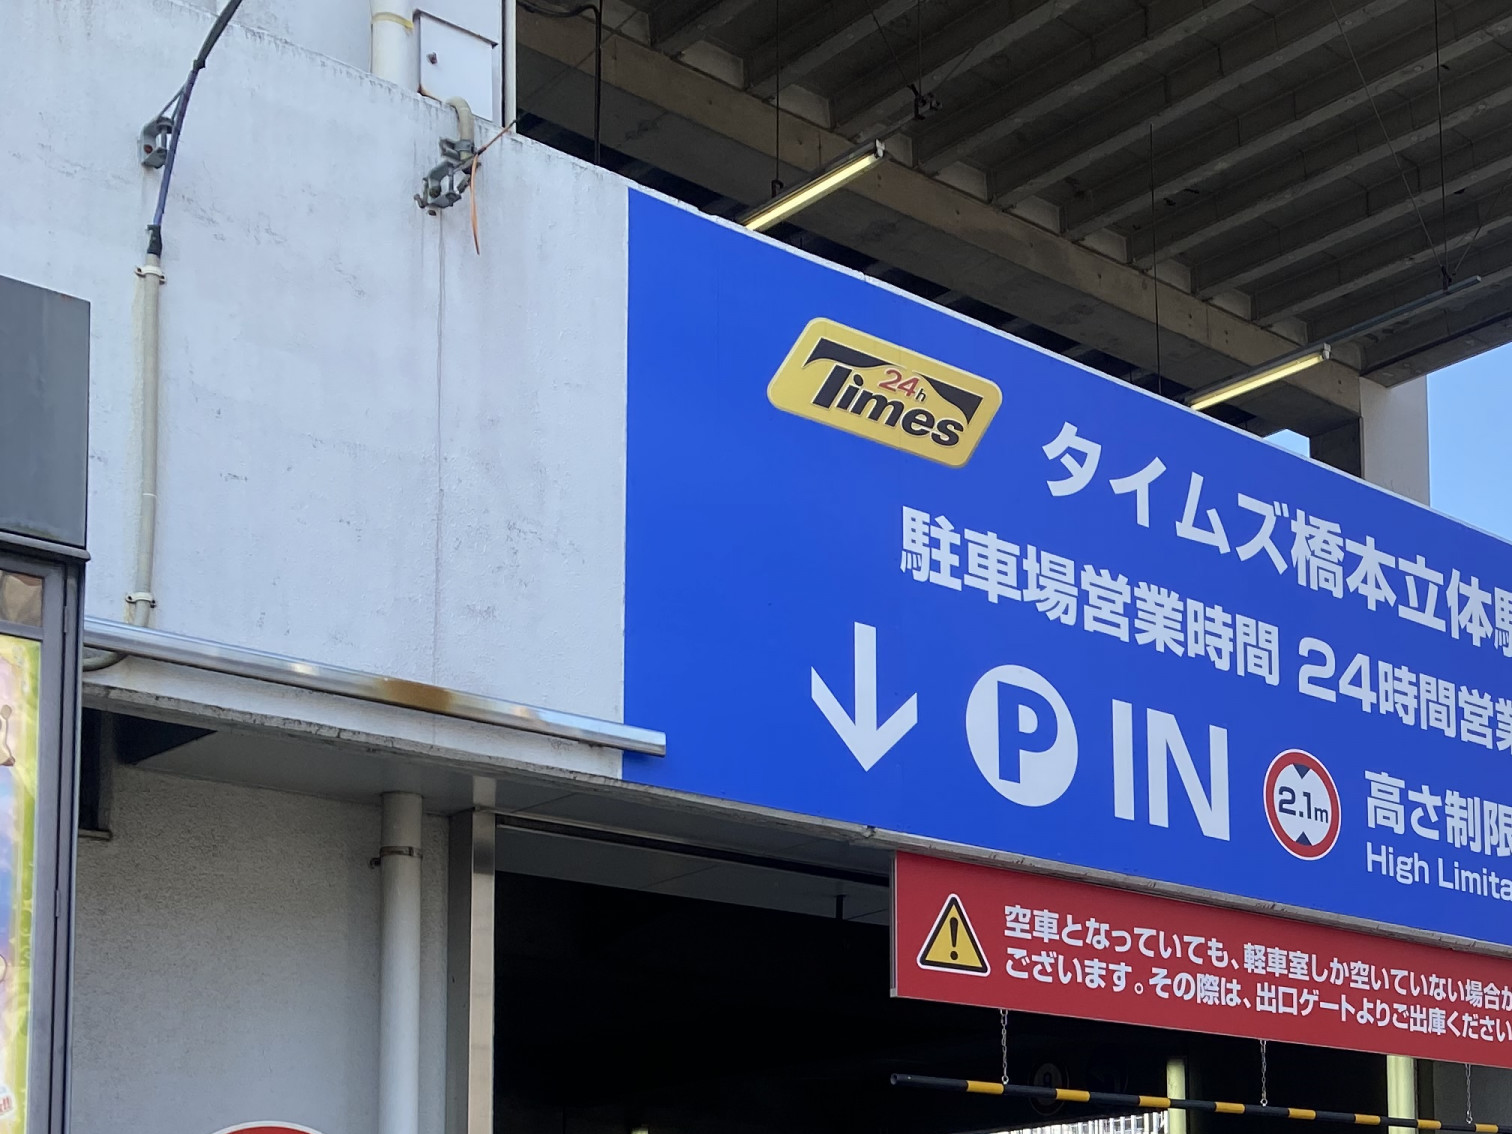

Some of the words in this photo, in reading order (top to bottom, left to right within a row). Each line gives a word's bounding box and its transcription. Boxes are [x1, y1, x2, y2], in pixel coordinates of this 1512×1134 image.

[802, 337, 964, 447] Times
[878, 368, 927, 402] 24h
[900, 505, 1280, 687] 駐車場営業時間
[1111, 698, 1230, 842] IN
[1277, 785, 1329, 825] 2.1m
[1366, 841, 1429, 885] High
